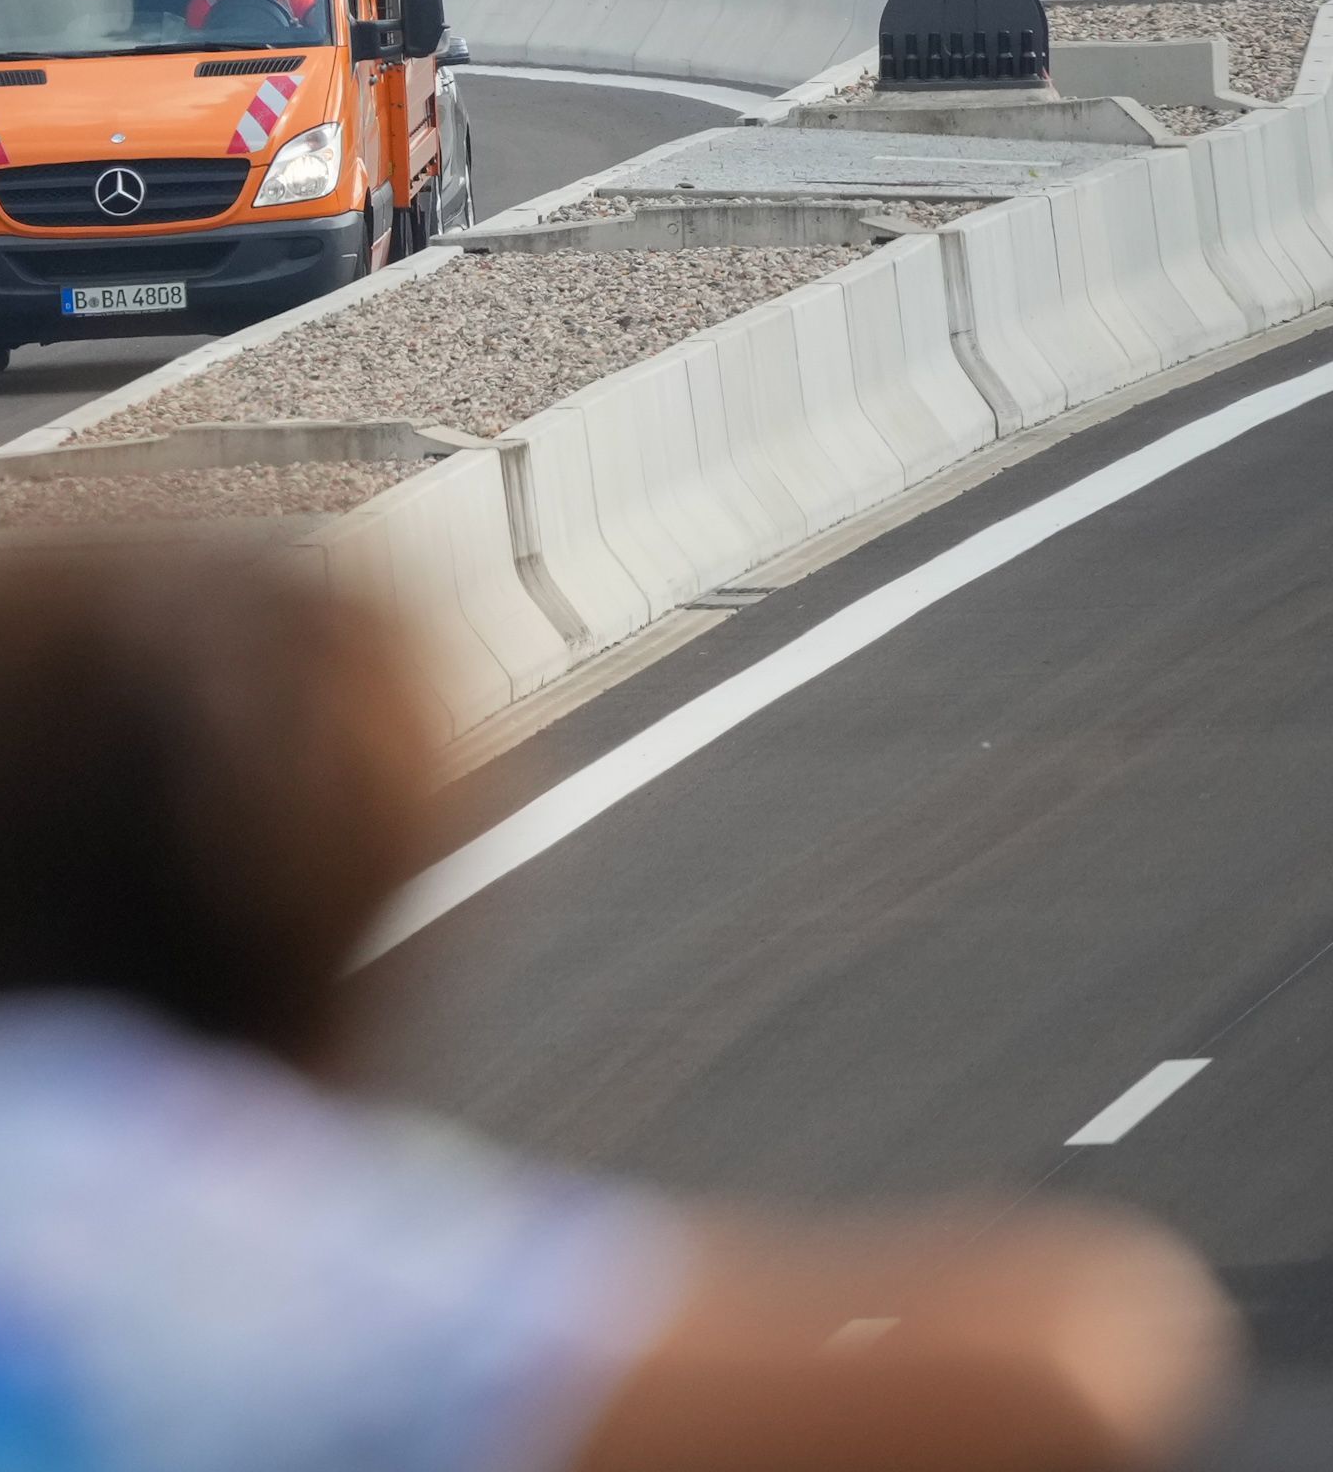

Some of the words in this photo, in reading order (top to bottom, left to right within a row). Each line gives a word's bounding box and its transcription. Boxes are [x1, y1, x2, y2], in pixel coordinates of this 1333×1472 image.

[74, 291, 87, 309] B
[101, 289, 127, 308] BA
[133, 286, 182, 307] 4808
